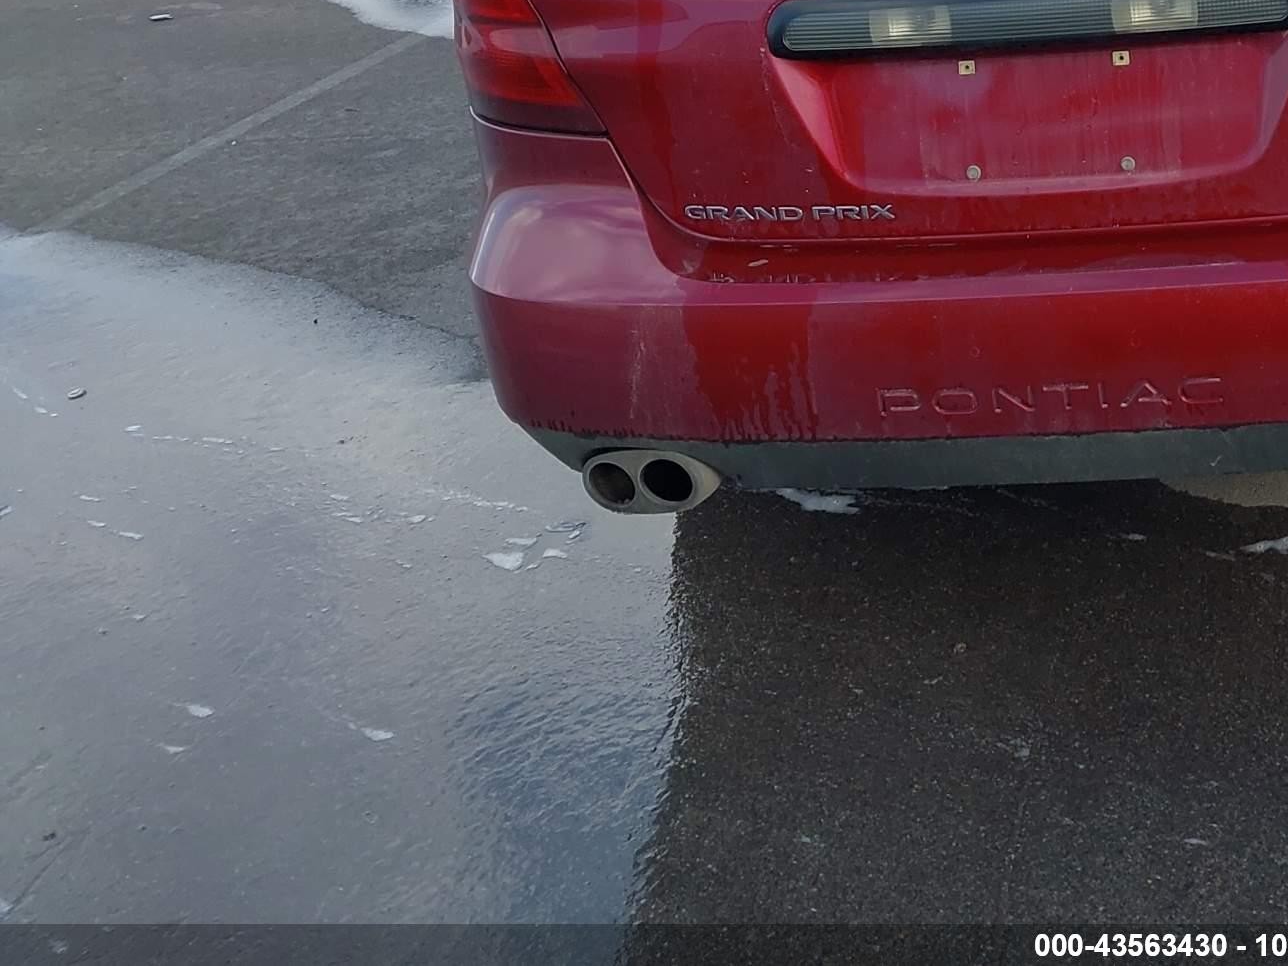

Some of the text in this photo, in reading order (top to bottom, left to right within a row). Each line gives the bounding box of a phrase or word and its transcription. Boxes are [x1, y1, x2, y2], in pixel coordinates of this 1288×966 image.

[684, 204, 896, 221] GRAND PRIX
[875, 377, 1225, 416] PONTIAC
